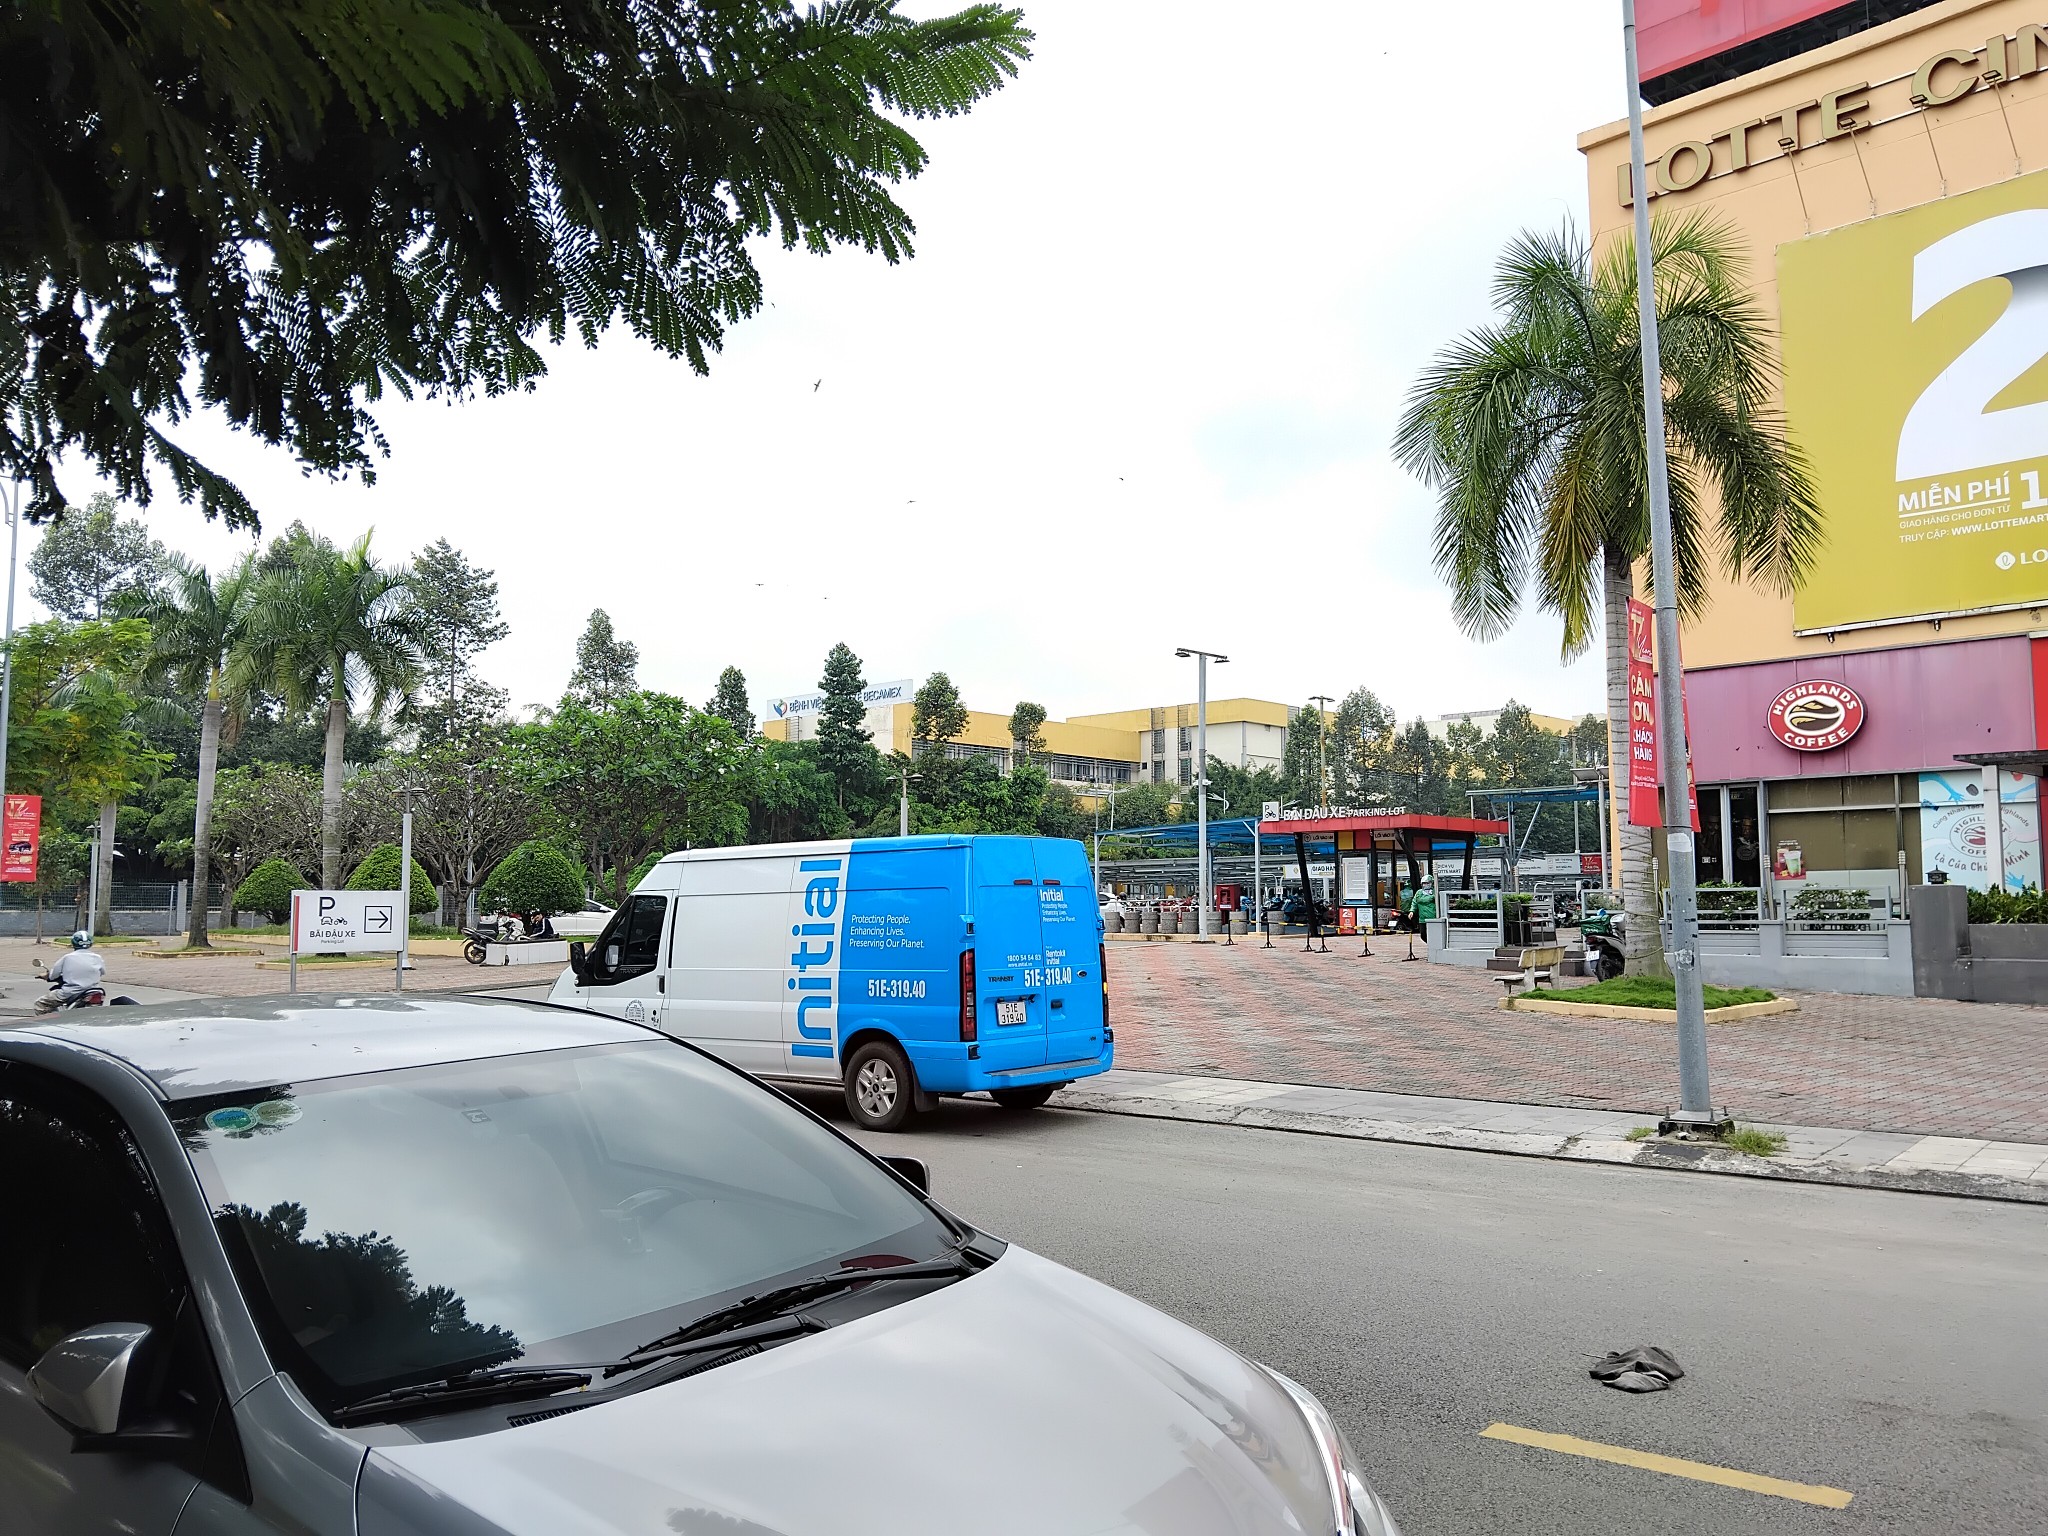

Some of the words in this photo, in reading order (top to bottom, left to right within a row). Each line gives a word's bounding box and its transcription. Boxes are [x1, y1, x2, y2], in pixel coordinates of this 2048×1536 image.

[1617, 81, 1872, 208] LOTTE
[1898, 482, 1961, 512] MIỄN
[1967, 470, 2011, 501] PHÍ
[1899, 518, 1922, 529] GIAO
[1923, 513, 1950, 526] HÀNG
[1951, 510, 1972, 522] CHO
[1973, 507, 1995, 518] ĐƠN
[1899, 532, 1924, 543] TRUY
[1926, 528, 1950, 540] CẬP:
[1631, 672, 1652, 698] CẢM
[789, 700, 810, 713] BỆNH
[863, 686, 902, 702] BECAMEX
[1772, 684, 1858, 716] HIGHLANDS
[1633, 701, 1651, 724] ƠN
[1784, 727, 1849, 747] COFFEE
[1633, 745, 1653, 762] HÀNG
[1284, 807, 1303, 821] BÃI
[1305, 805, 1328, 822] ĐẬU
[1331, 806, 1346, 818] XE
[1348, 807, 1388, 818] PARKING
[1389, 806, 1406, 816] LOT
[1932, 815, 1948, 829] Cùng
[1947, 807, 1966, 817] Nhau
[1040, 889, 1064, 901] Initial
[319, 897, 335, 916] P
[851, 915, 885, 925] Protecting
[886, 914, 911, 924] People.
[310, 929, 323, 938] BÃI
[326, 929, 343, 939] ĐẬU
[850, 926, 885, 937] Enhancing
[886, 926, 905, 936] Lives.
[849, 938, 884, 949] Preserving
[886, 938, 899, 948] Our
[901, 938, 924, 949] Planet.
[788, 859, 842, 1059] Initial
[1046, 957, 1060, 965] Initial
[1024, 967, 1072, 987] 51E-319.40
[868, 979, 926, 998] 51E-319.40
[1005, 1004, 1018, 1013] 51E
[1001, 1013, 1024, 1024] 319.40
